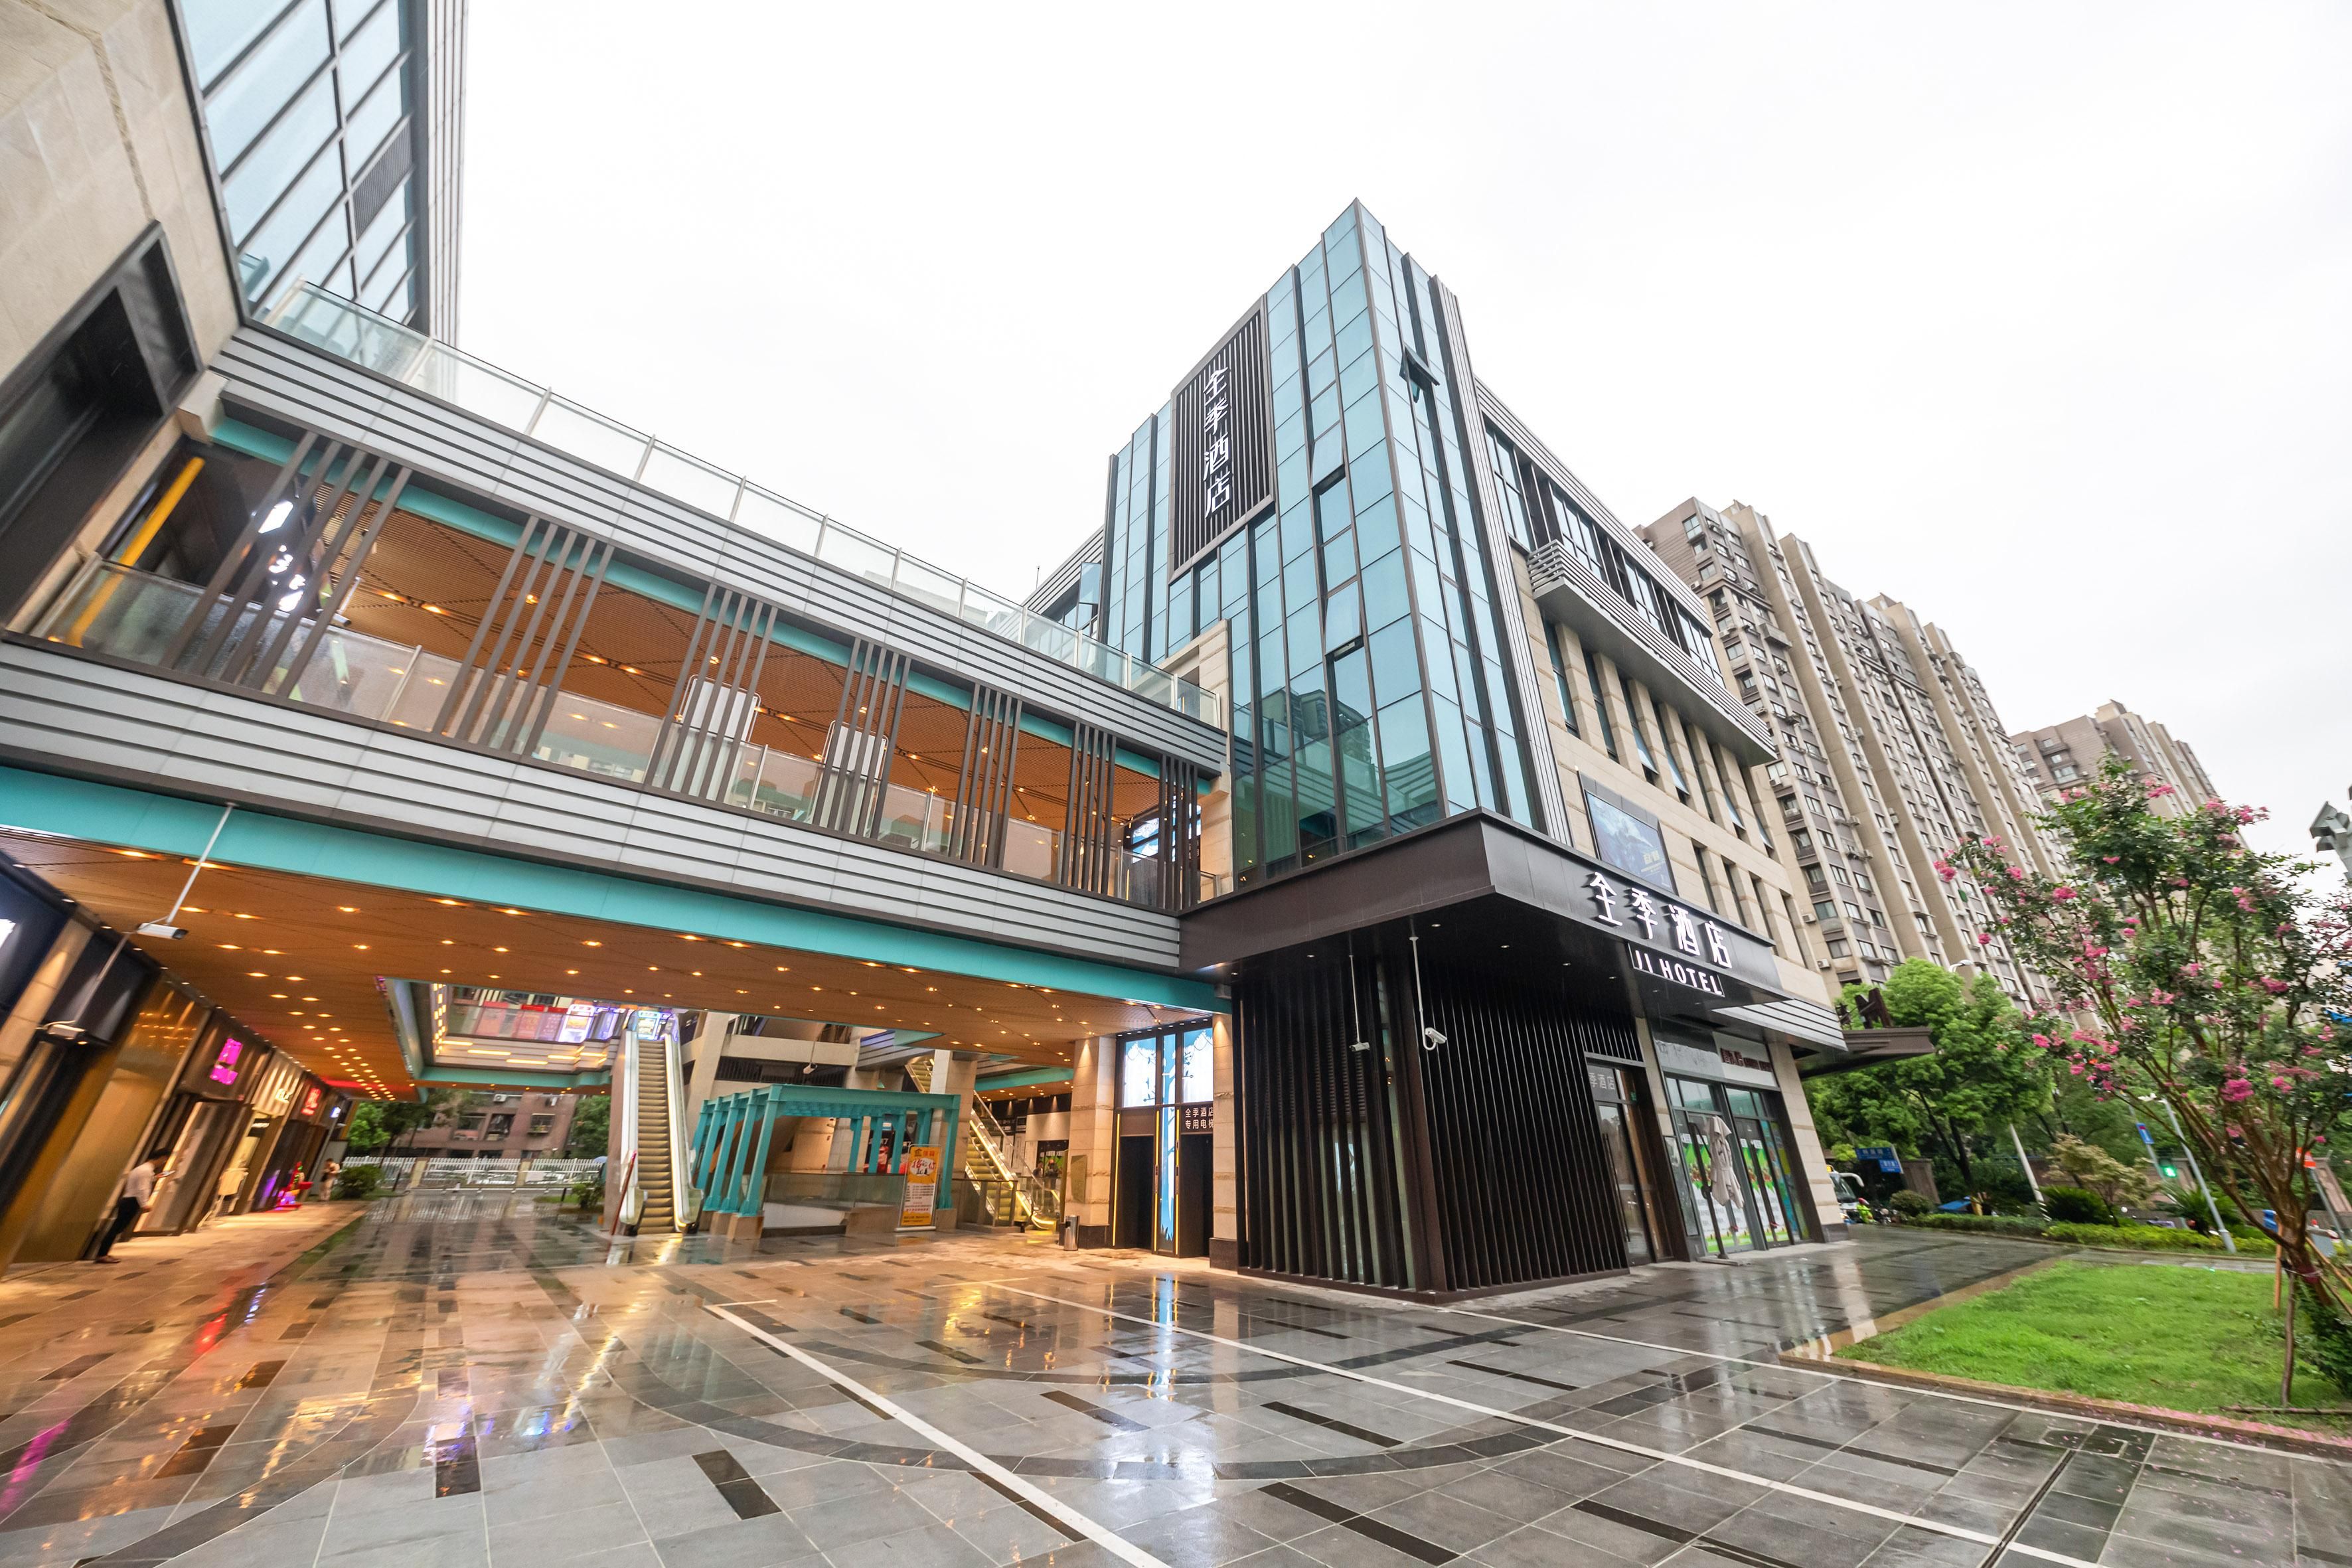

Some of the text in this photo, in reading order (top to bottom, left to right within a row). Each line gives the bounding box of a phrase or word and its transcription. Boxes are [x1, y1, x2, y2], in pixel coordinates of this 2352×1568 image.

[1203, 366, 1230, 519] 全季酒店
[1590, 872, 1733, 969] 全季酒店
[1635, 950, 1722, 995] JI HOTEL
